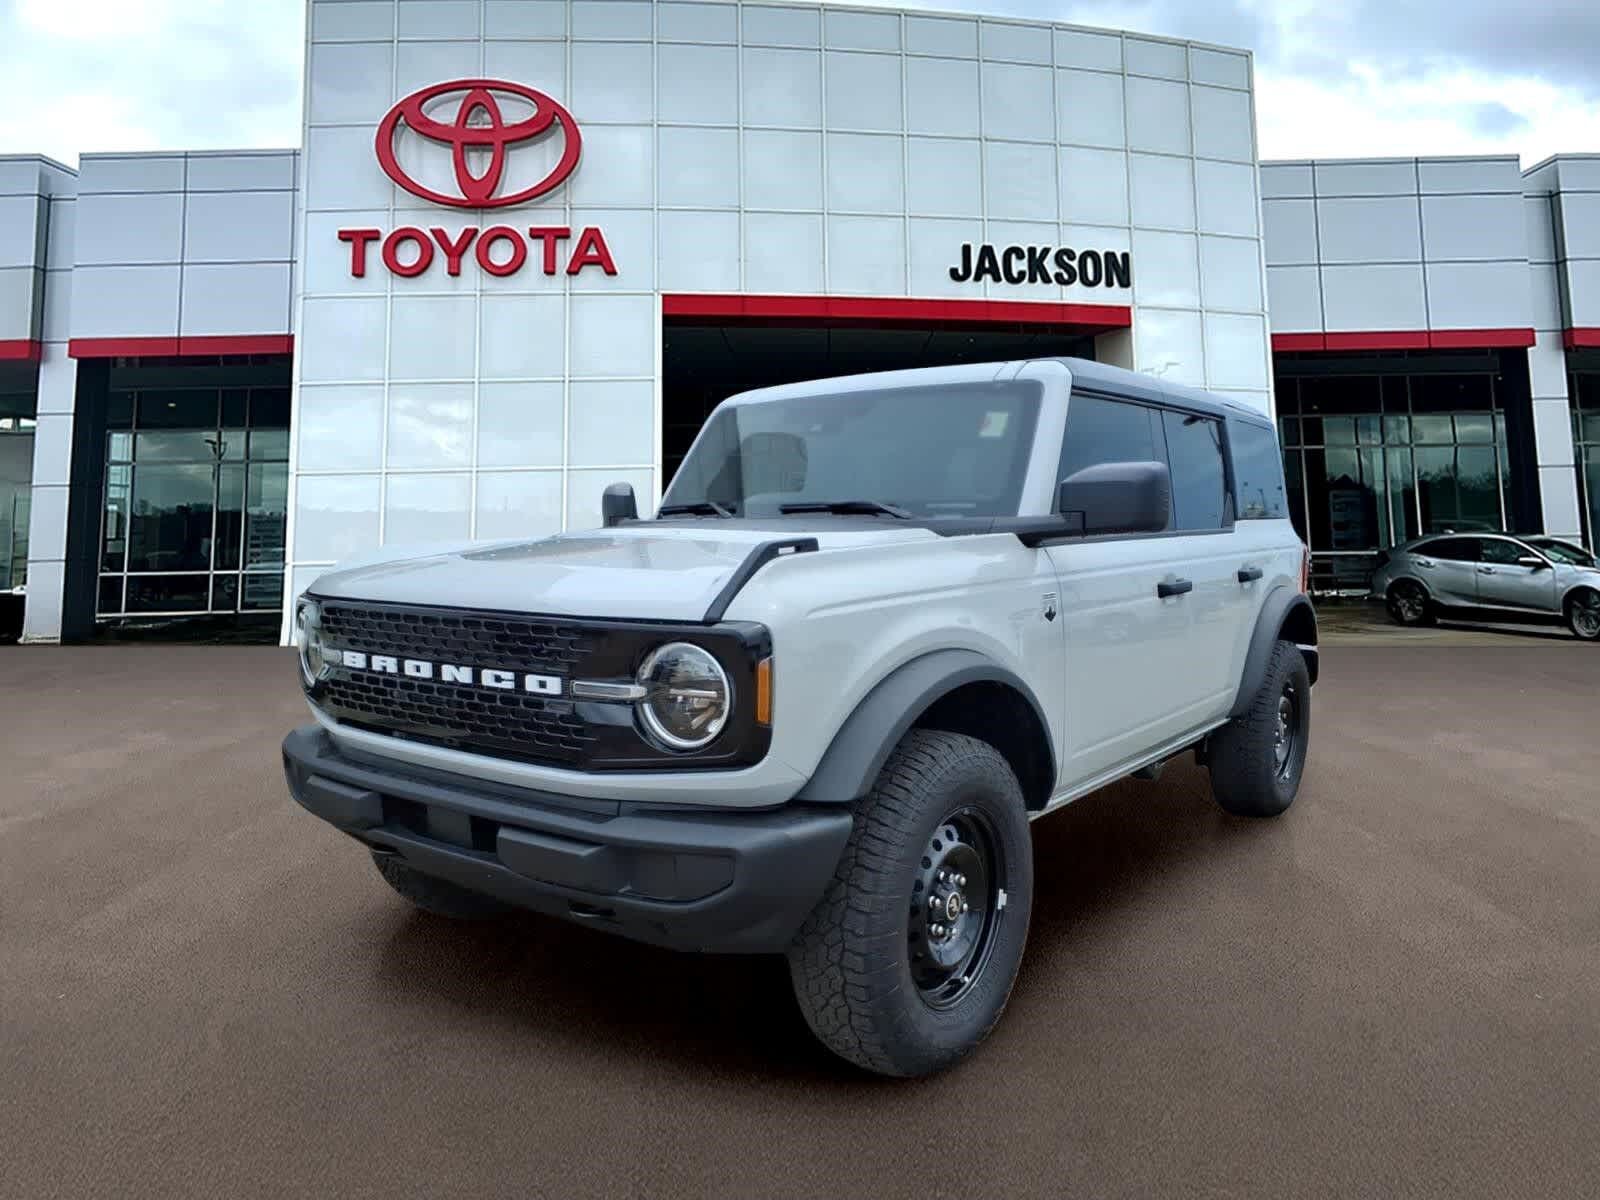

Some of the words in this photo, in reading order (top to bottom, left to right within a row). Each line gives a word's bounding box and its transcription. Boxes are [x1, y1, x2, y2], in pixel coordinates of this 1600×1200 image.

[337, 226, 618, 278] TOYOTA
[949, 244, 1131, 288] JACKSON
[343, 651, 562, 695] BRONCO
